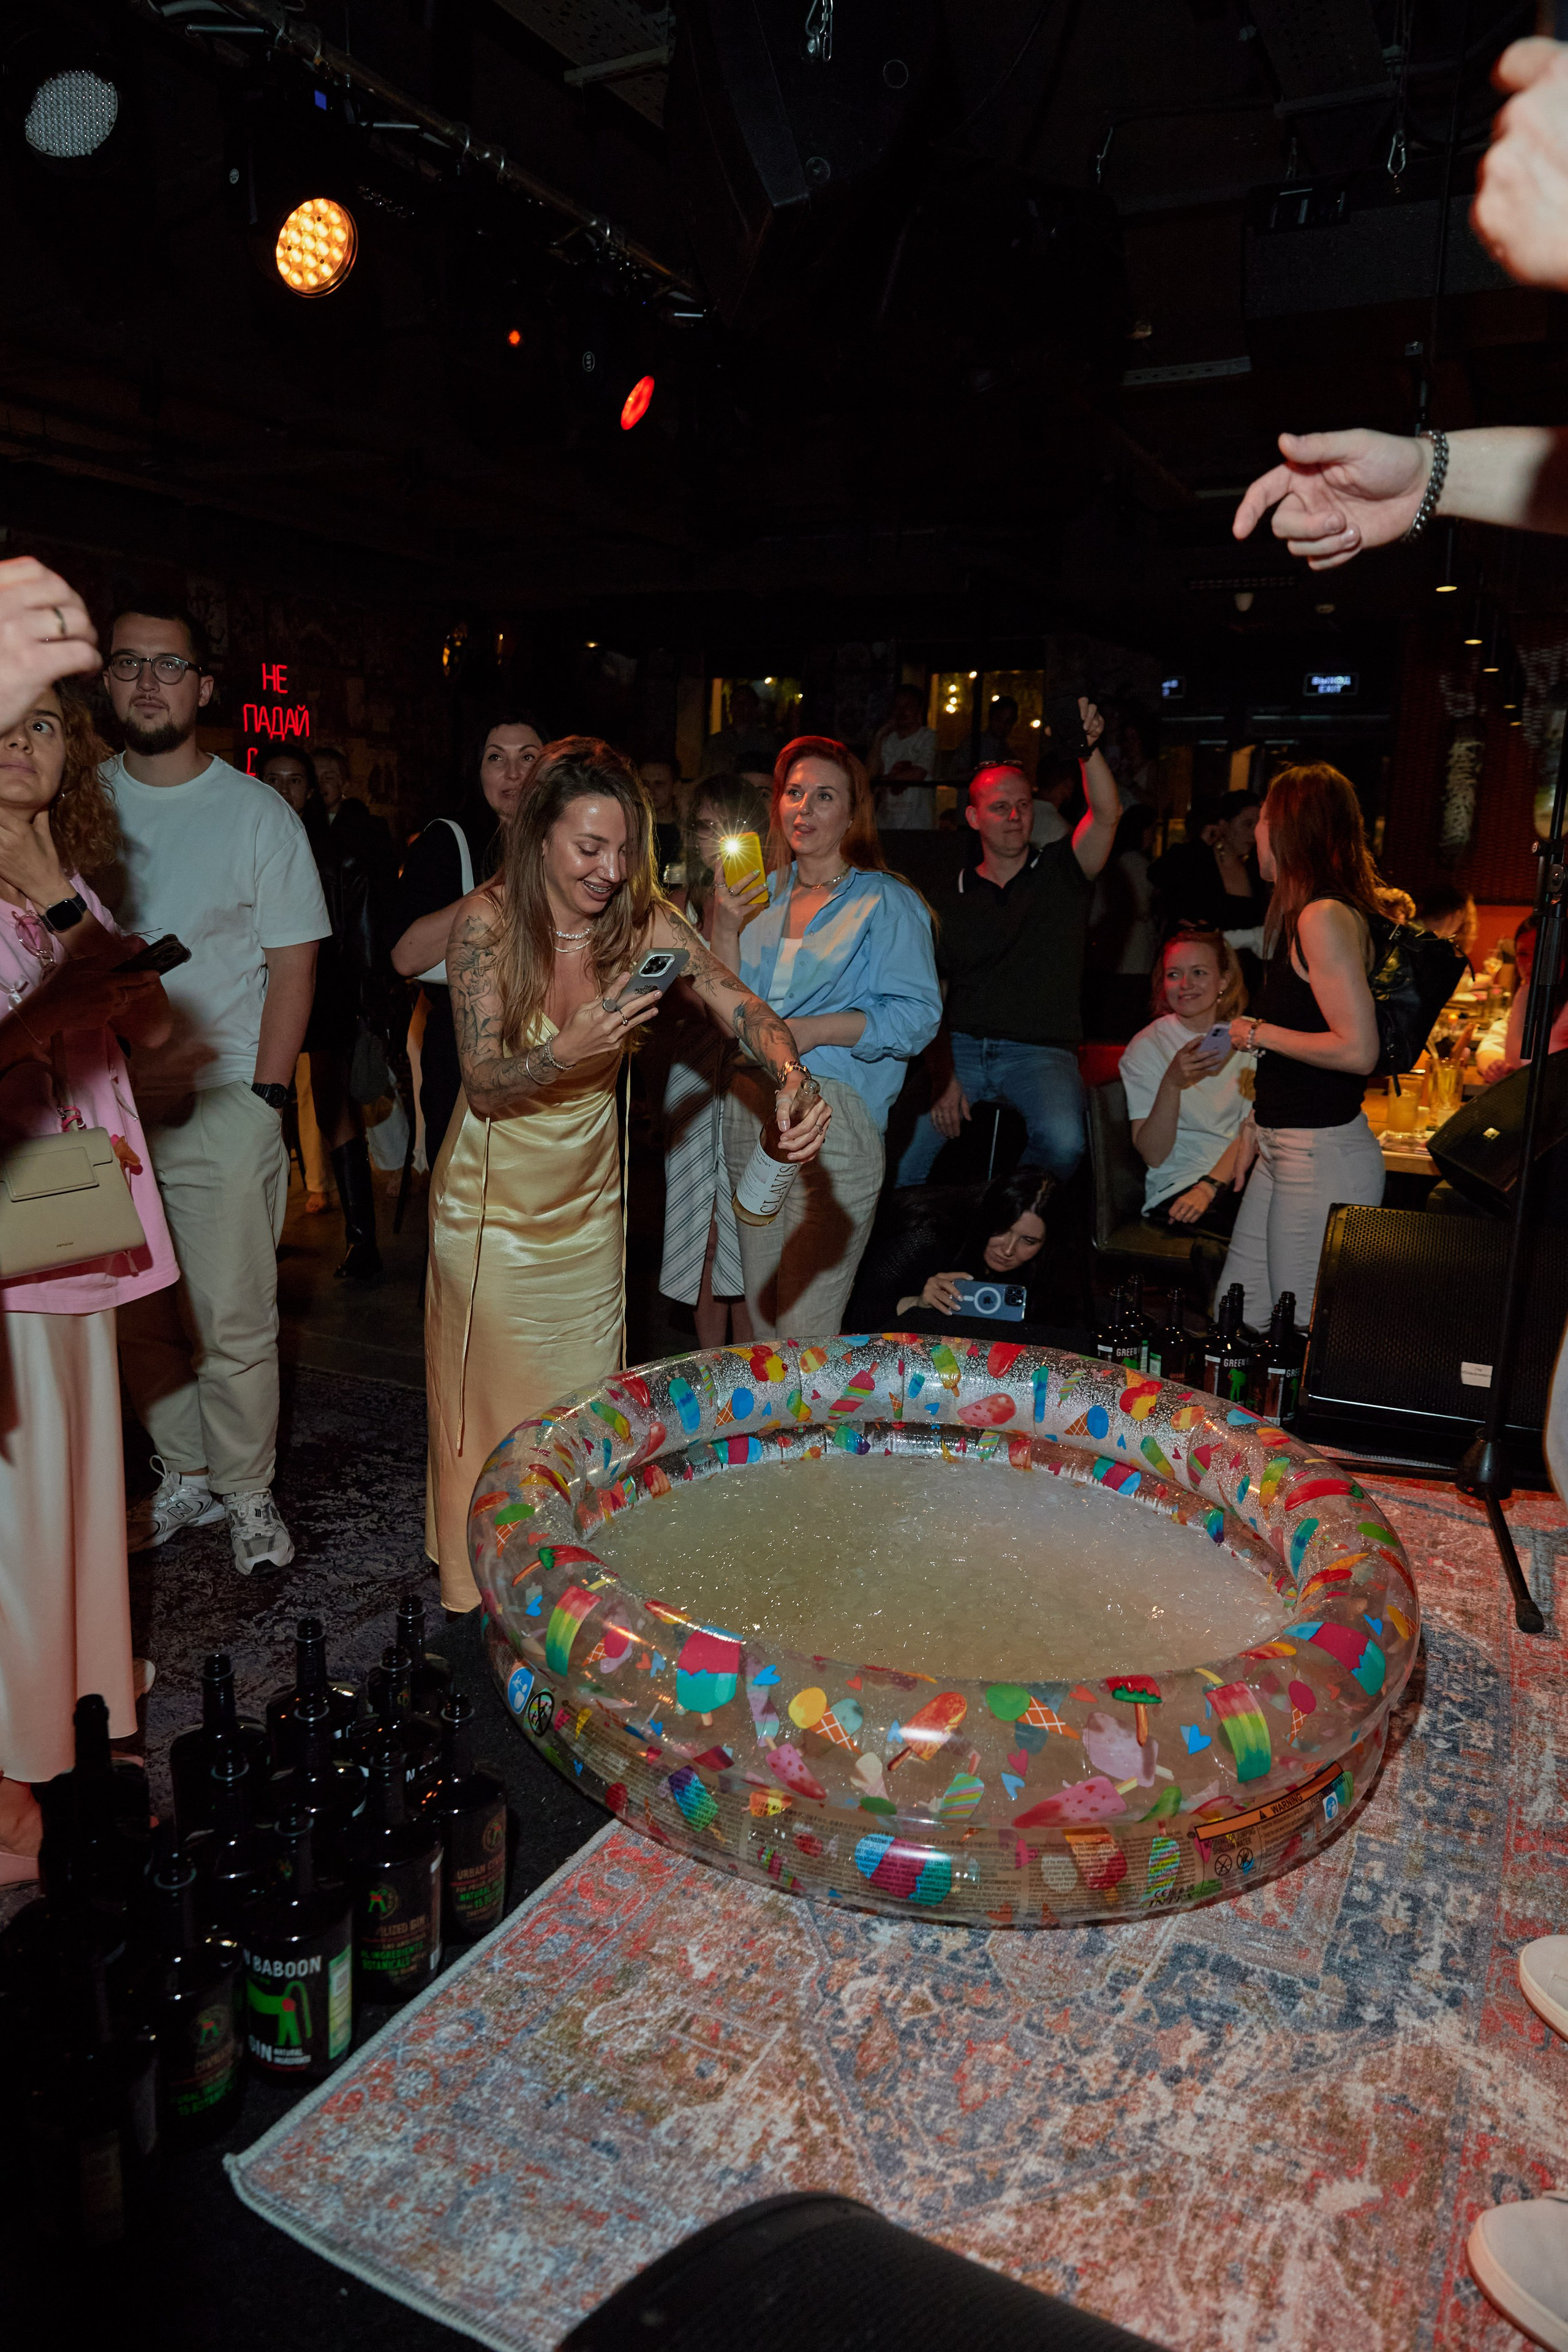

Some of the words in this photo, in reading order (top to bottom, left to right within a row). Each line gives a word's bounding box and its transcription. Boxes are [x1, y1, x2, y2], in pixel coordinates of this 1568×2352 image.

[262, 663, 288, 693] НЕ
[243, 704, 309, 741] ПАДАЙ
[760, 1165, 797, 1213] CLAVIS
[1224, 1358, 1246, 1367] GREEN
[1270, 1793, 1303, 1814] WARNING
[456, 1863, 486, 1880] URBAN
[252, 1955, 322, 1978] BABOON
